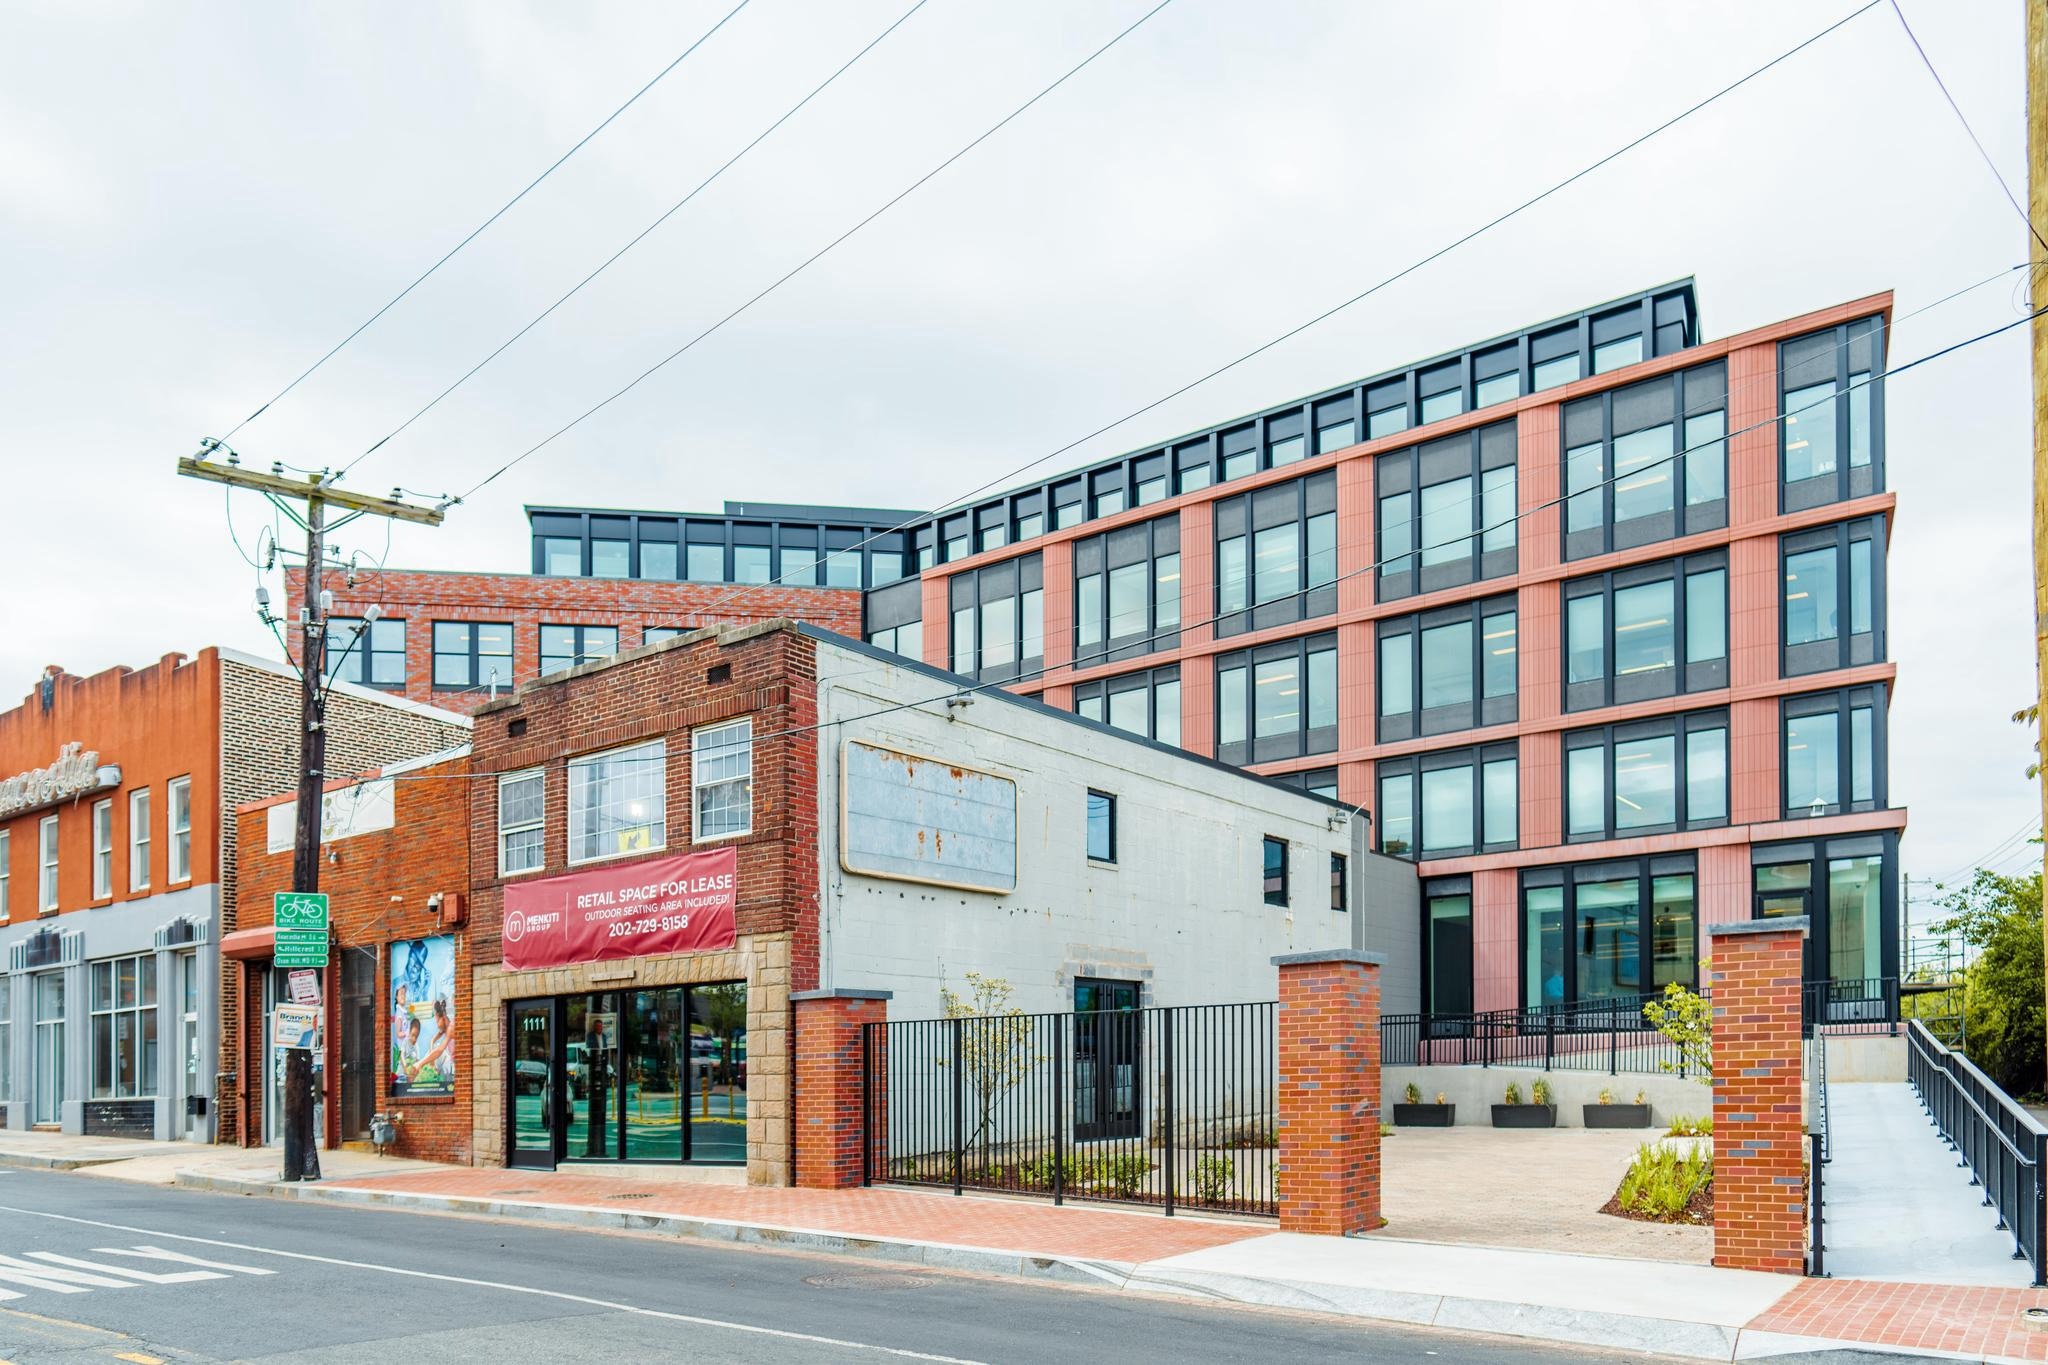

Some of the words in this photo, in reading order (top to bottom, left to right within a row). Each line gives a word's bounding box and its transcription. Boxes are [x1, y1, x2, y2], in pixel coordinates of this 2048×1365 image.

[577, 891, 616, 909] RETAIL
[619, 885, 656, 904] SPACE
[660, 881, 687, 898] FOR
[691, 874, 733, 893] LEASE
[585, 908, 622, 922] OUTDOOR
[623, 903, 658, 916] SEATING
[660, 899, 683, 911] AREA
[684, 893, 730, 909] INCLUDED!
[527, 912, 559, 926] MENKITI
[527, 924, 551, 932] GROUP
[609, 915, 688, 937] 202-729-8158
[279, 1013, 312, 1021] Branch
[523, 1016, 545, 1031] 1111
[0, 1245, 280, 1300] NLY
